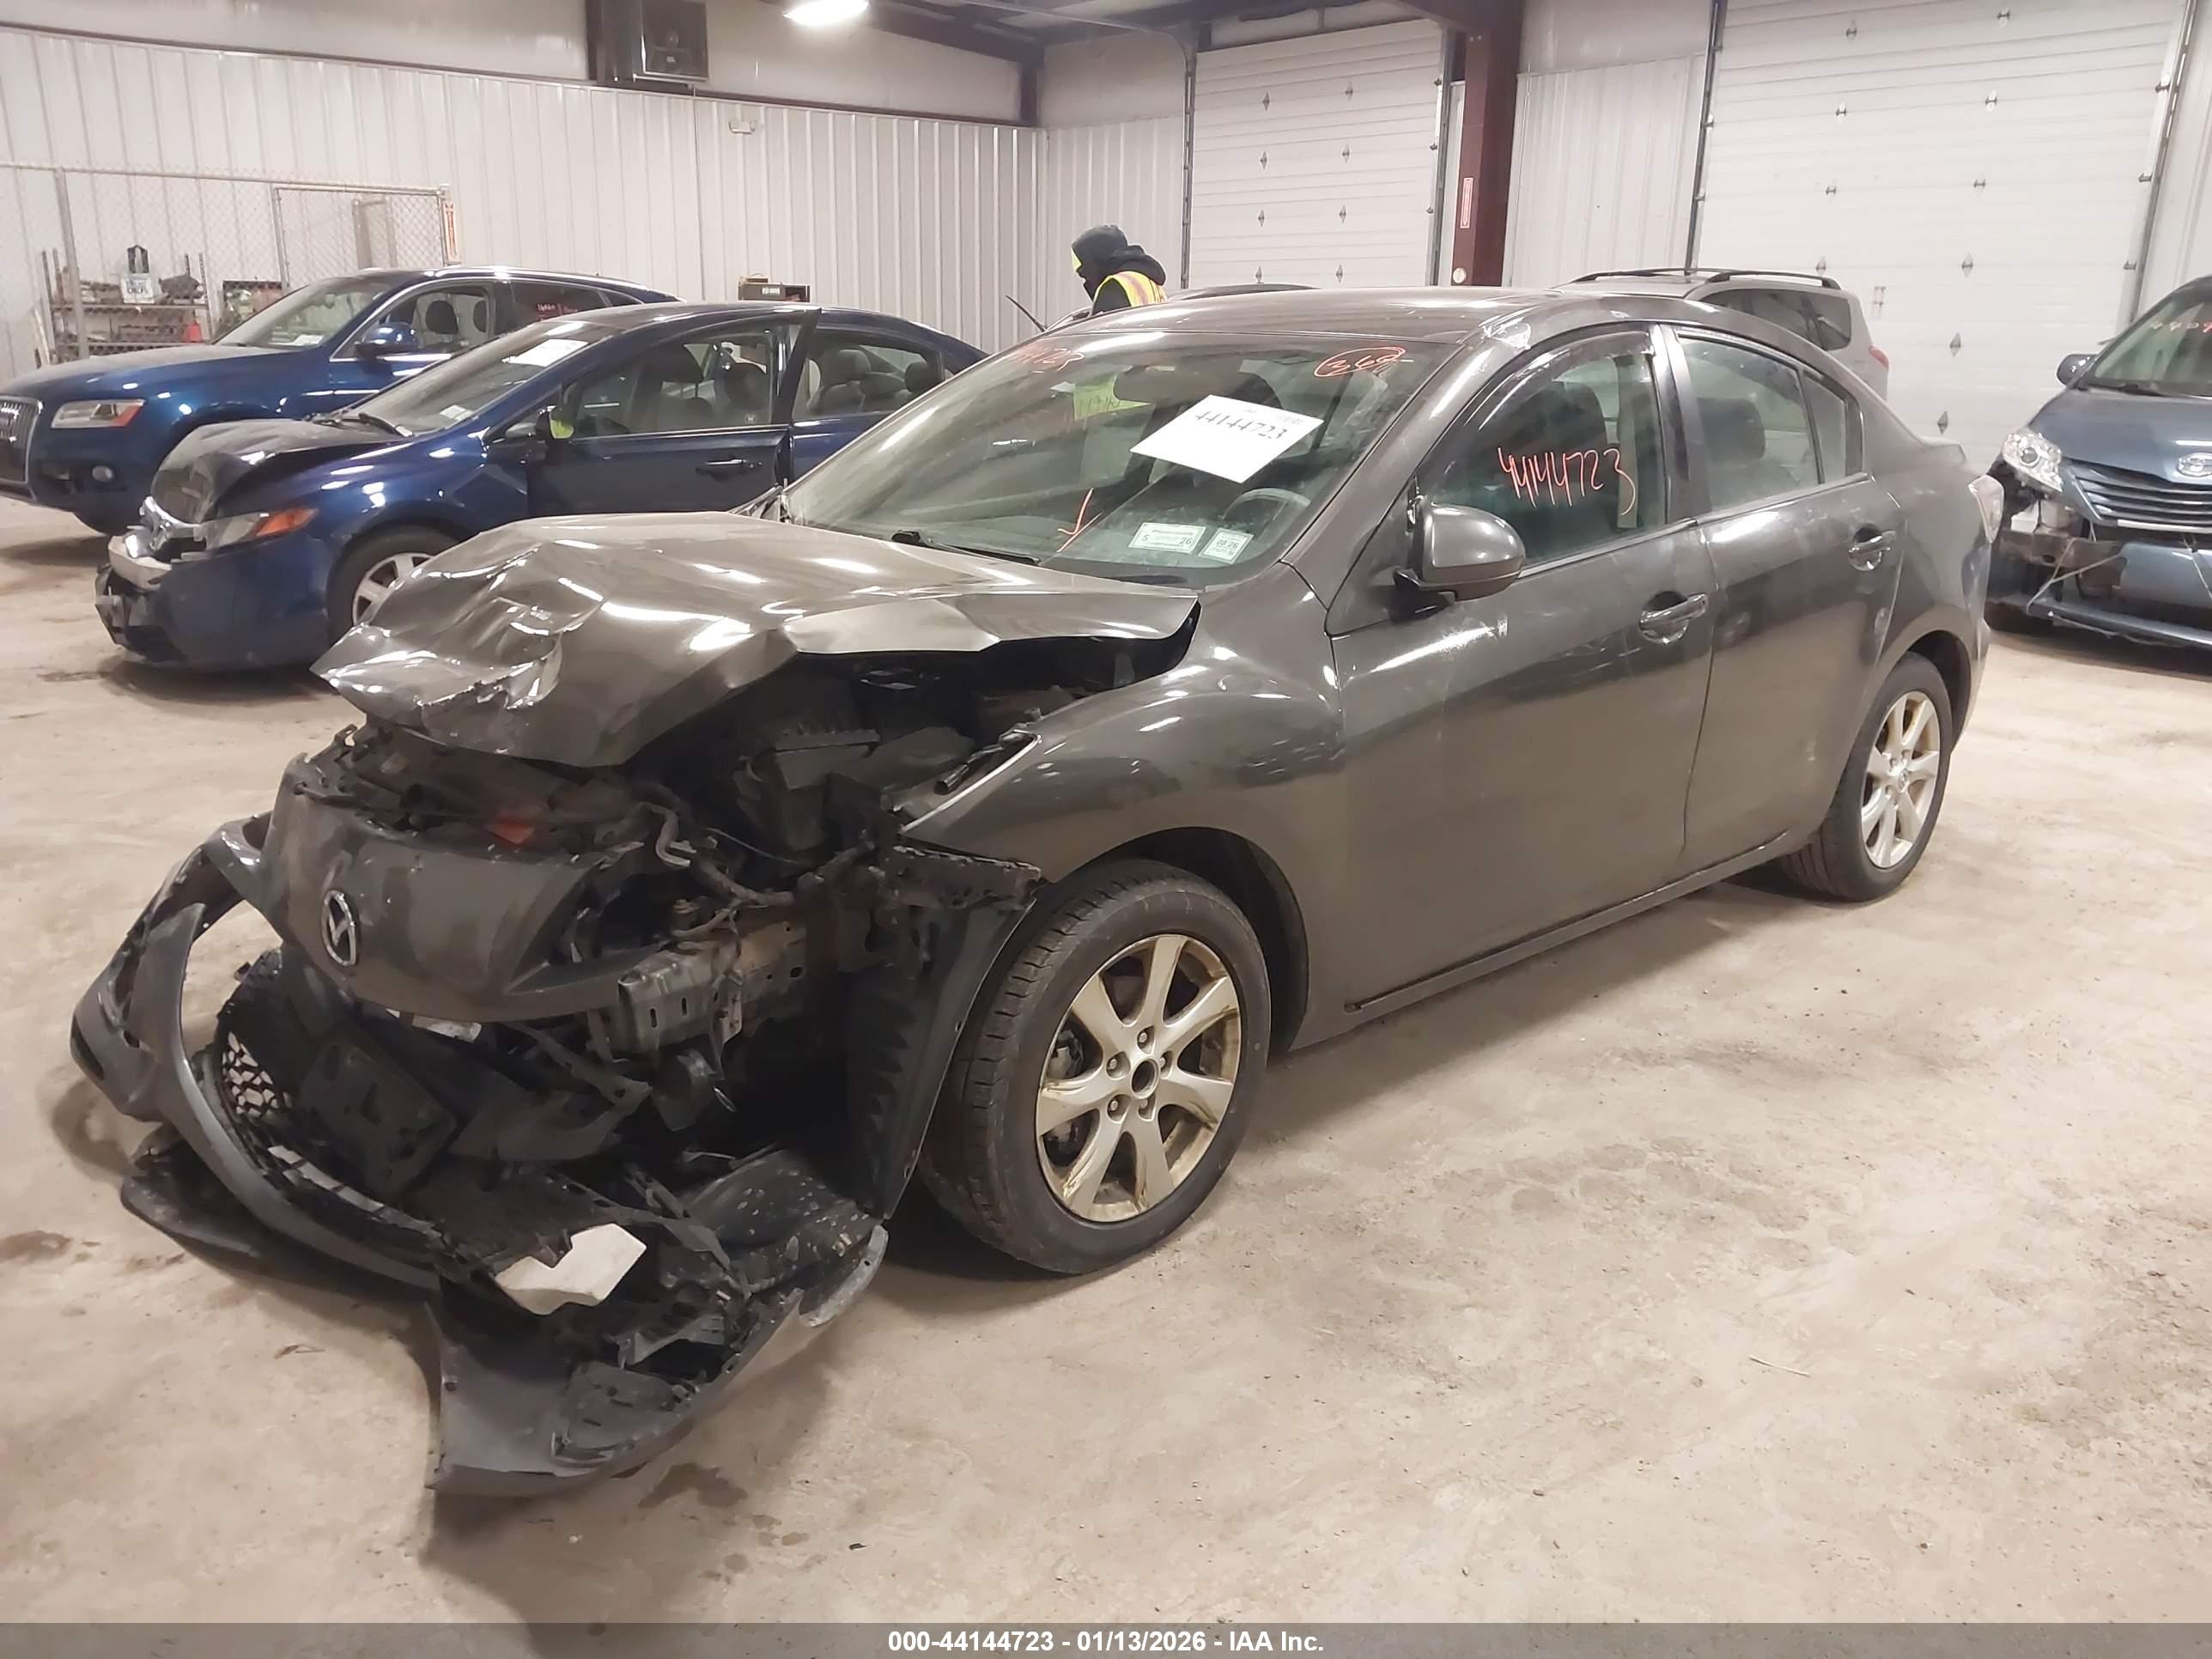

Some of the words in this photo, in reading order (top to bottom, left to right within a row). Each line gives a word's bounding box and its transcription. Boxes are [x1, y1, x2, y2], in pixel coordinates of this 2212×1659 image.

[1194, 410, 1289, 440] 44144723
[1497, 446, 1636, 516] 44144723
[1179, 537, 1193, 545] 26
